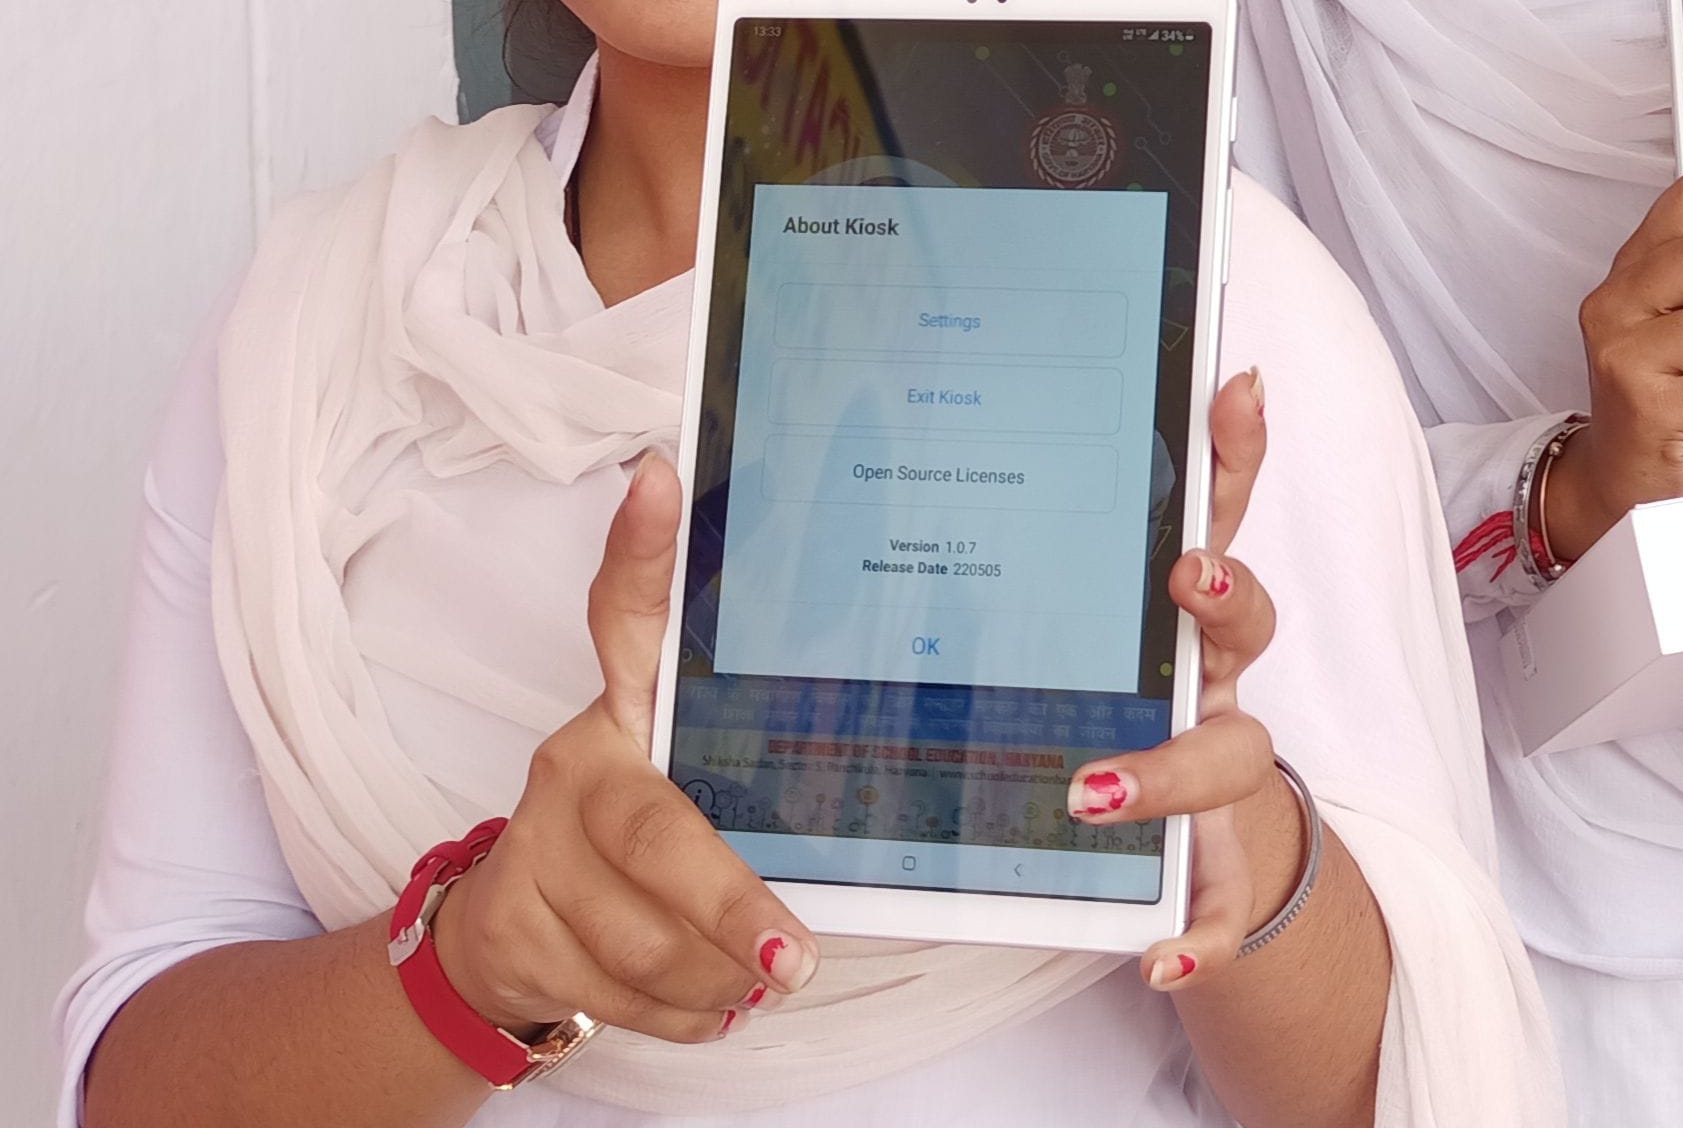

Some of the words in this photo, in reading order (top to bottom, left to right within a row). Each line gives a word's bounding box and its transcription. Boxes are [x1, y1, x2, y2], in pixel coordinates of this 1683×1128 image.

[754, 25, 782, 37] 13:33
[1161, 30, 1184, 41] 34%
[783, 216, 839, 236] About
[845, 217, 899, 237] Kiosk
[918, 312, 981, 332] Settings
[907, 389, 935, 406] Exit
[939, 389, 981, 407] Kiosk
[853, 464, 893, 482] Open
[897, 465, 952, 482] Source
[956, 466, 1025, 485] Licenses
[889, 539, 939, 554] Version
[946, 542, 977, 554] 1.0.7
[862, 560, 914, 575] Release
[917, 561, 948, 576] Date
[953, 564, 1001, 578] 220505
[912, 637, 941, 656] OK
